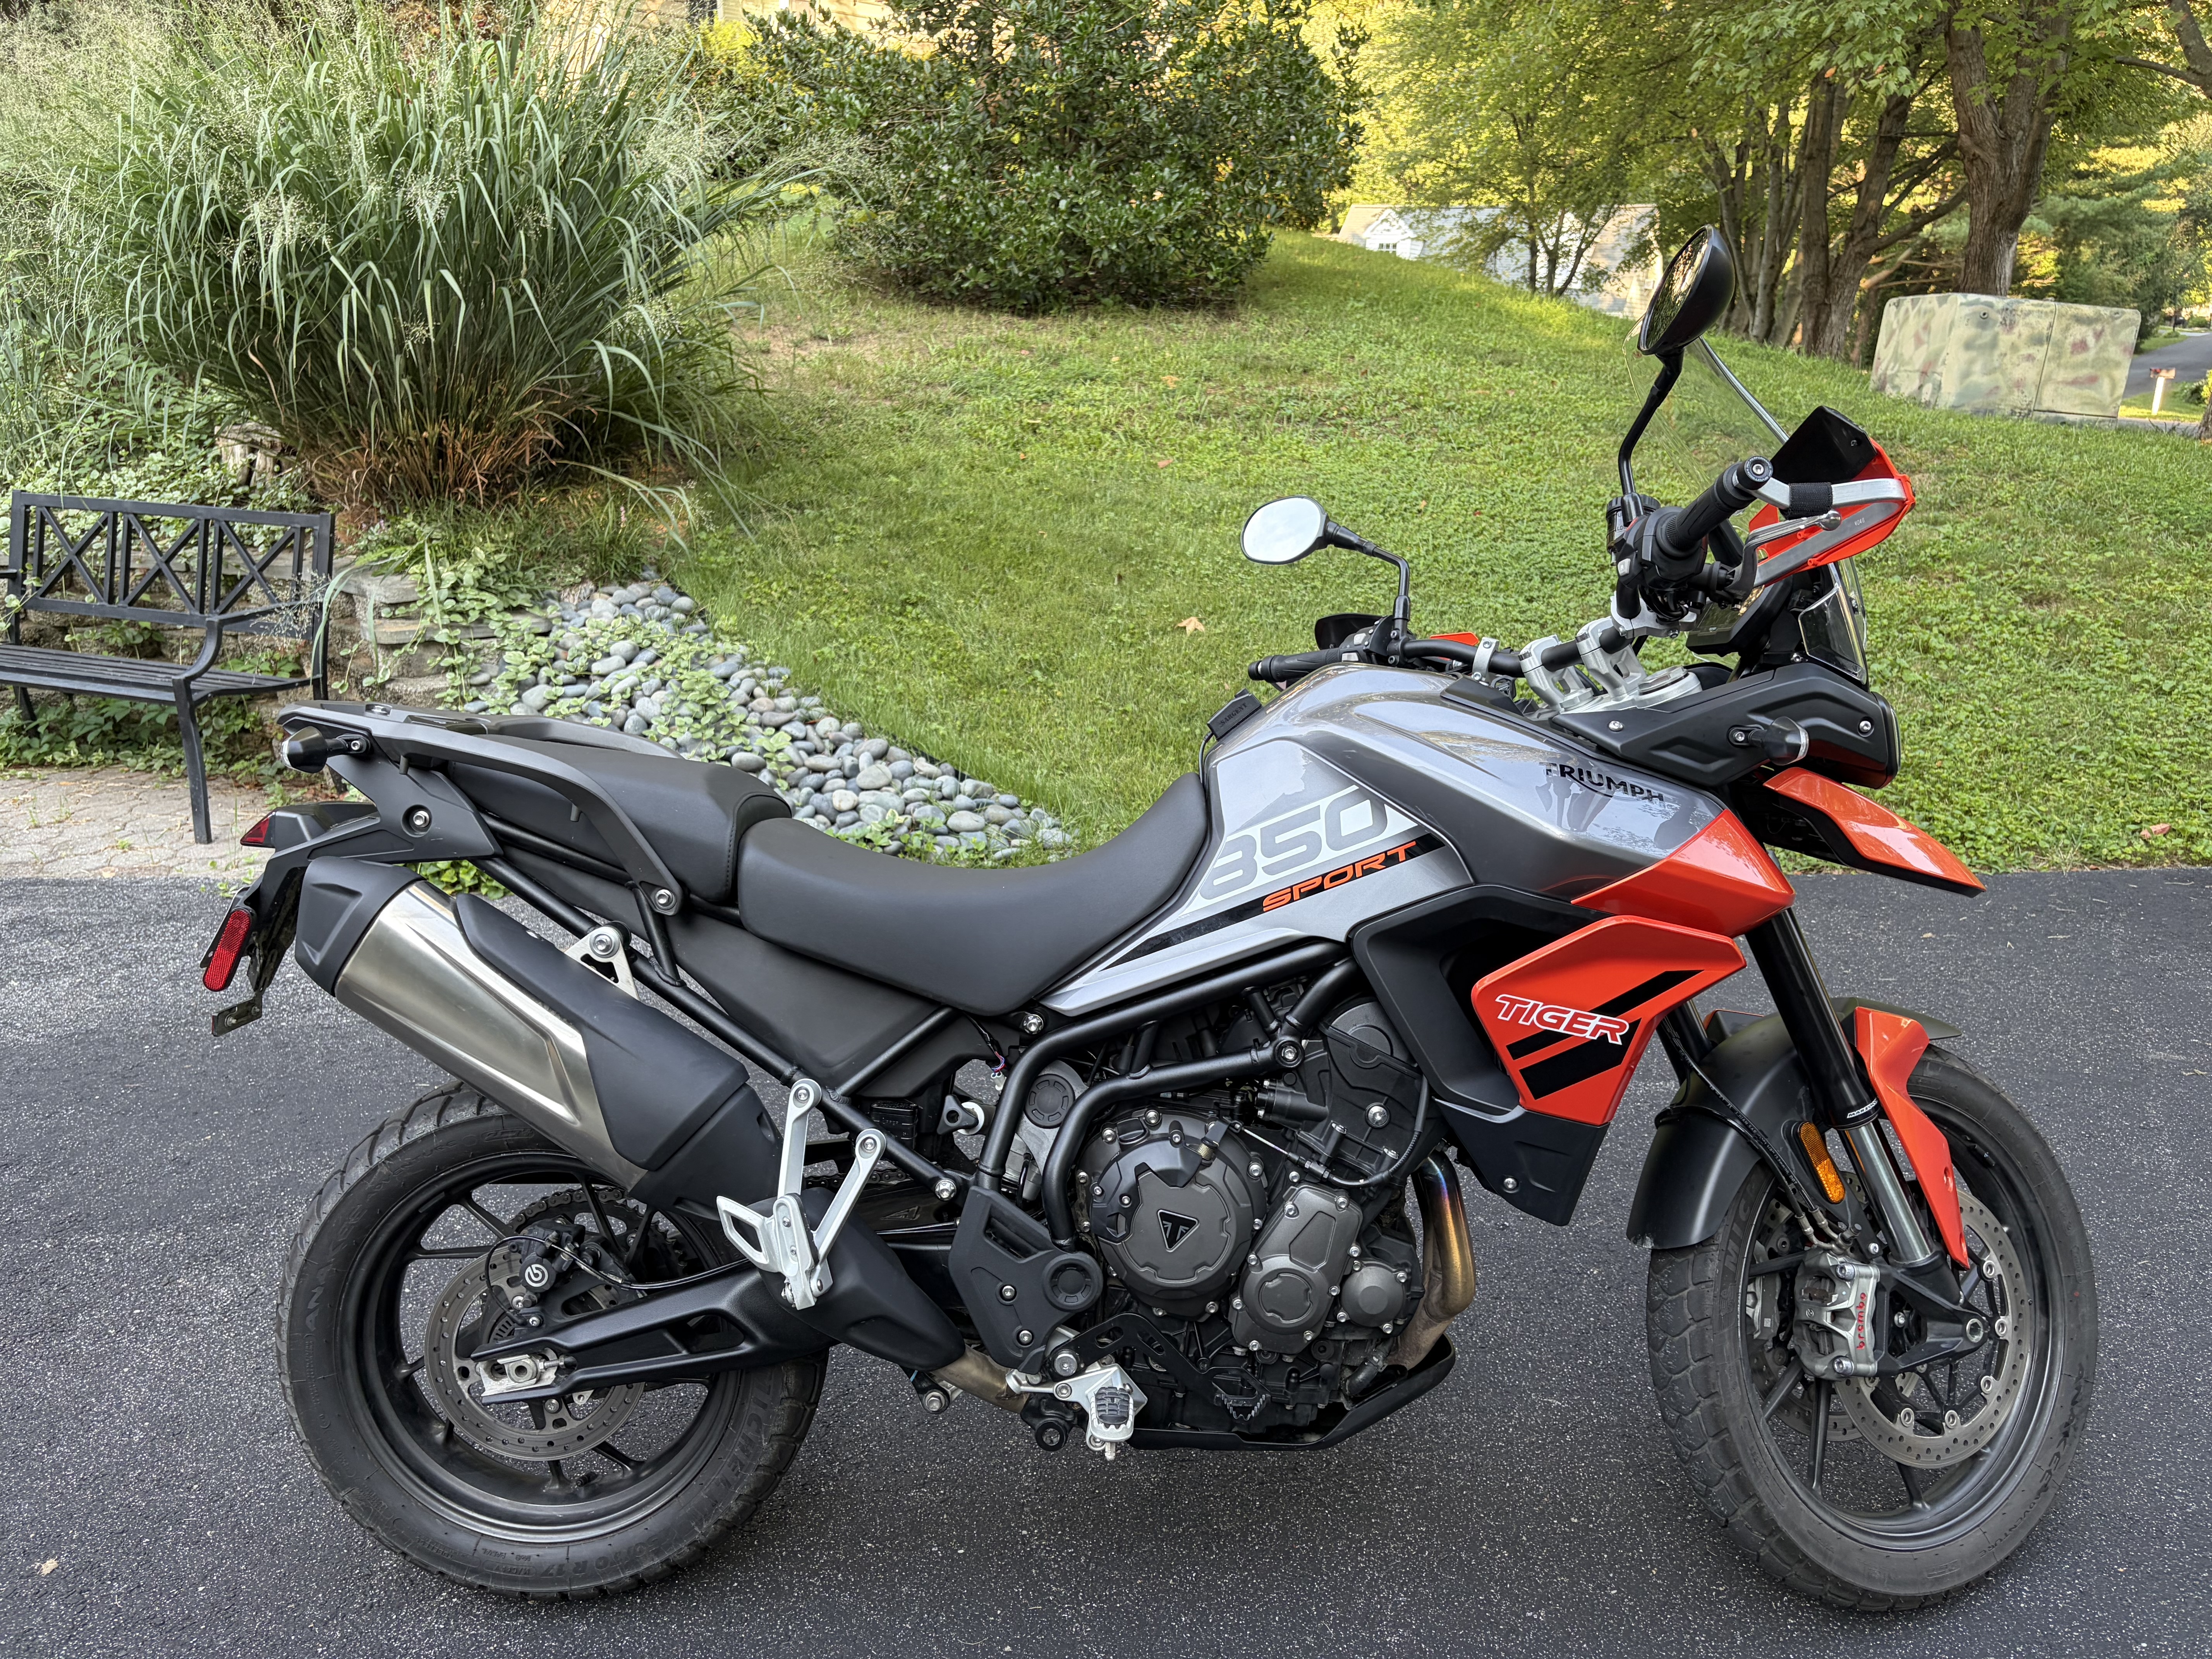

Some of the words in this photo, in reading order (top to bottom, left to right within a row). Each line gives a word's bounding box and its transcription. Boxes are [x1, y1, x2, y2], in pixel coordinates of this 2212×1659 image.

[1220, 702, 1247, 727] SARGENT
[1539, 761, 1664, 803] TRIUMPH
[1200, 793, 1388, 900] 850
[1262, 841, 1416, 912] SPORT
[1495, 994, 1629, 1045] TIGER
[1788, 1175, 1798, 1185] DOT
[1856, 1292, 1867, 1350] brembo
